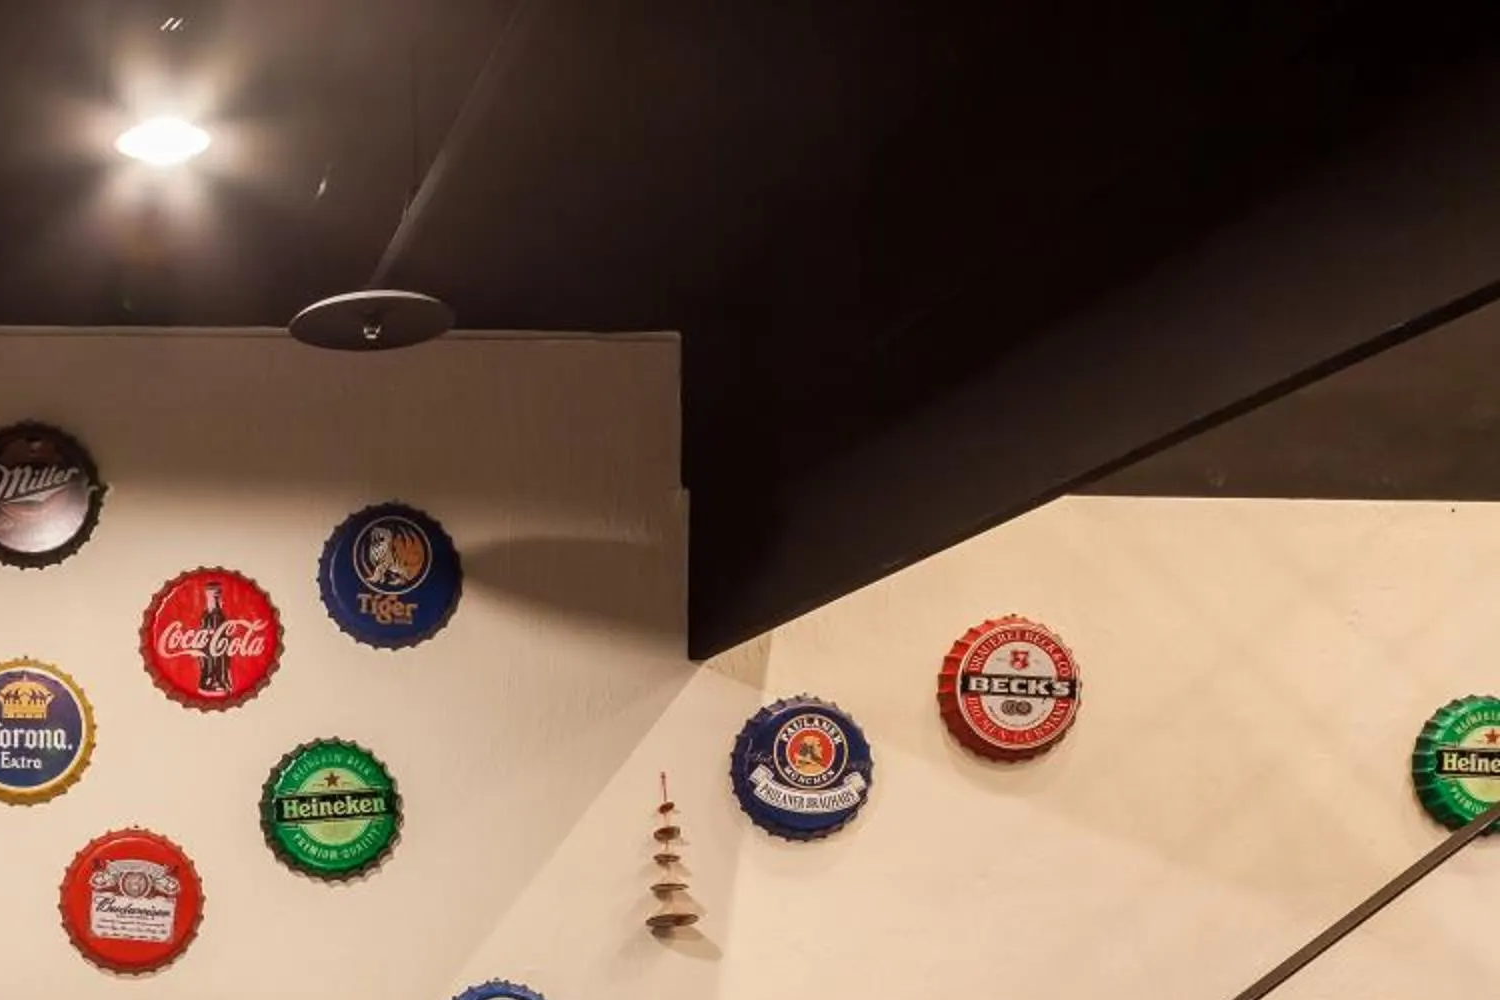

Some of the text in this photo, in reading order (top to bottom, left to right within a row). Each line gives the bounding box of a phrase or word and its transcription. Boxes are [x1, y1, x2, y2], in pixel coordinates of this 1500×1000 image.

[357, 593, 418, 625] Tiger
[158, 619, 269, 659] Coca-Cola
[0, 751, 42, 769] Extra
[282, 795, 387, 819] Heineken
